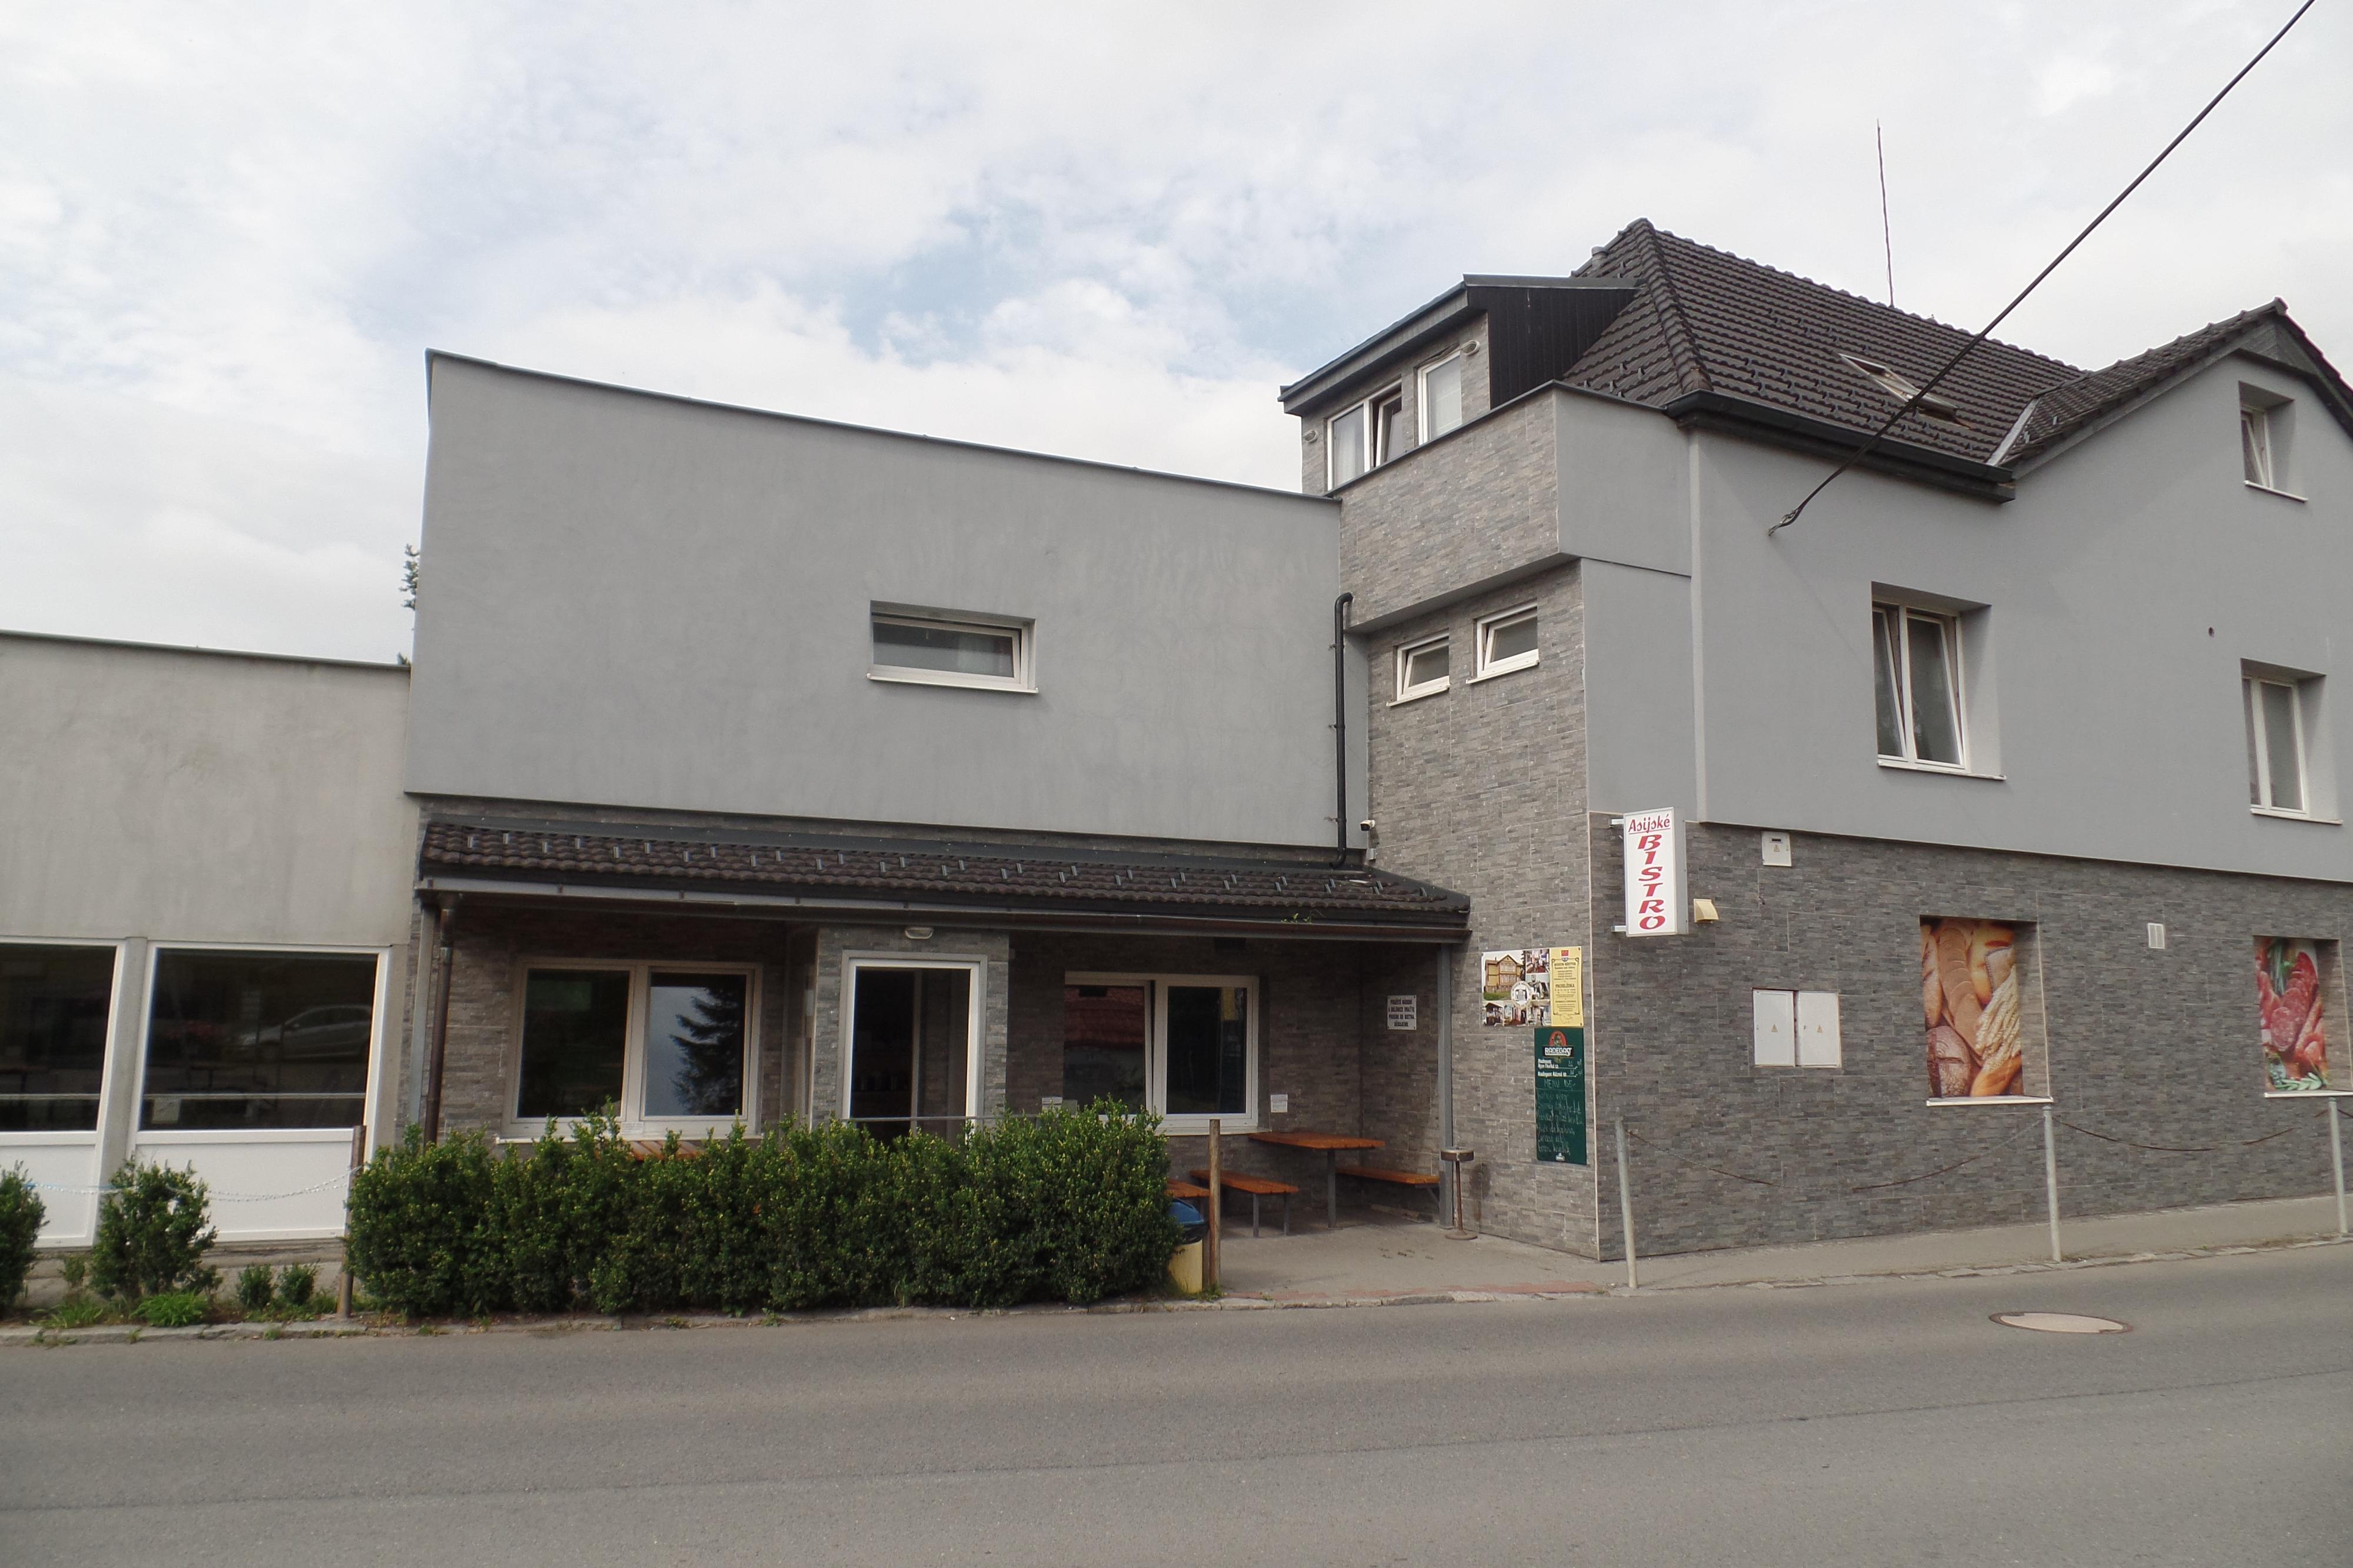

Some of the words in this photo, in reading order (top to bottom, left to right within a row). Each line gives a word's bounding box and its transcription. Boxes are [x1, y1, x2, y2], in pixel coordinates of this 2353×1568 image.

[1628, 813, 1671, 833] Asijské
[1637, 834, 1666, 930] BISTRO
[1544, 1047, 1572, 1056] RADEGAST
[1544, 1078, 1559, 1088] MENU
